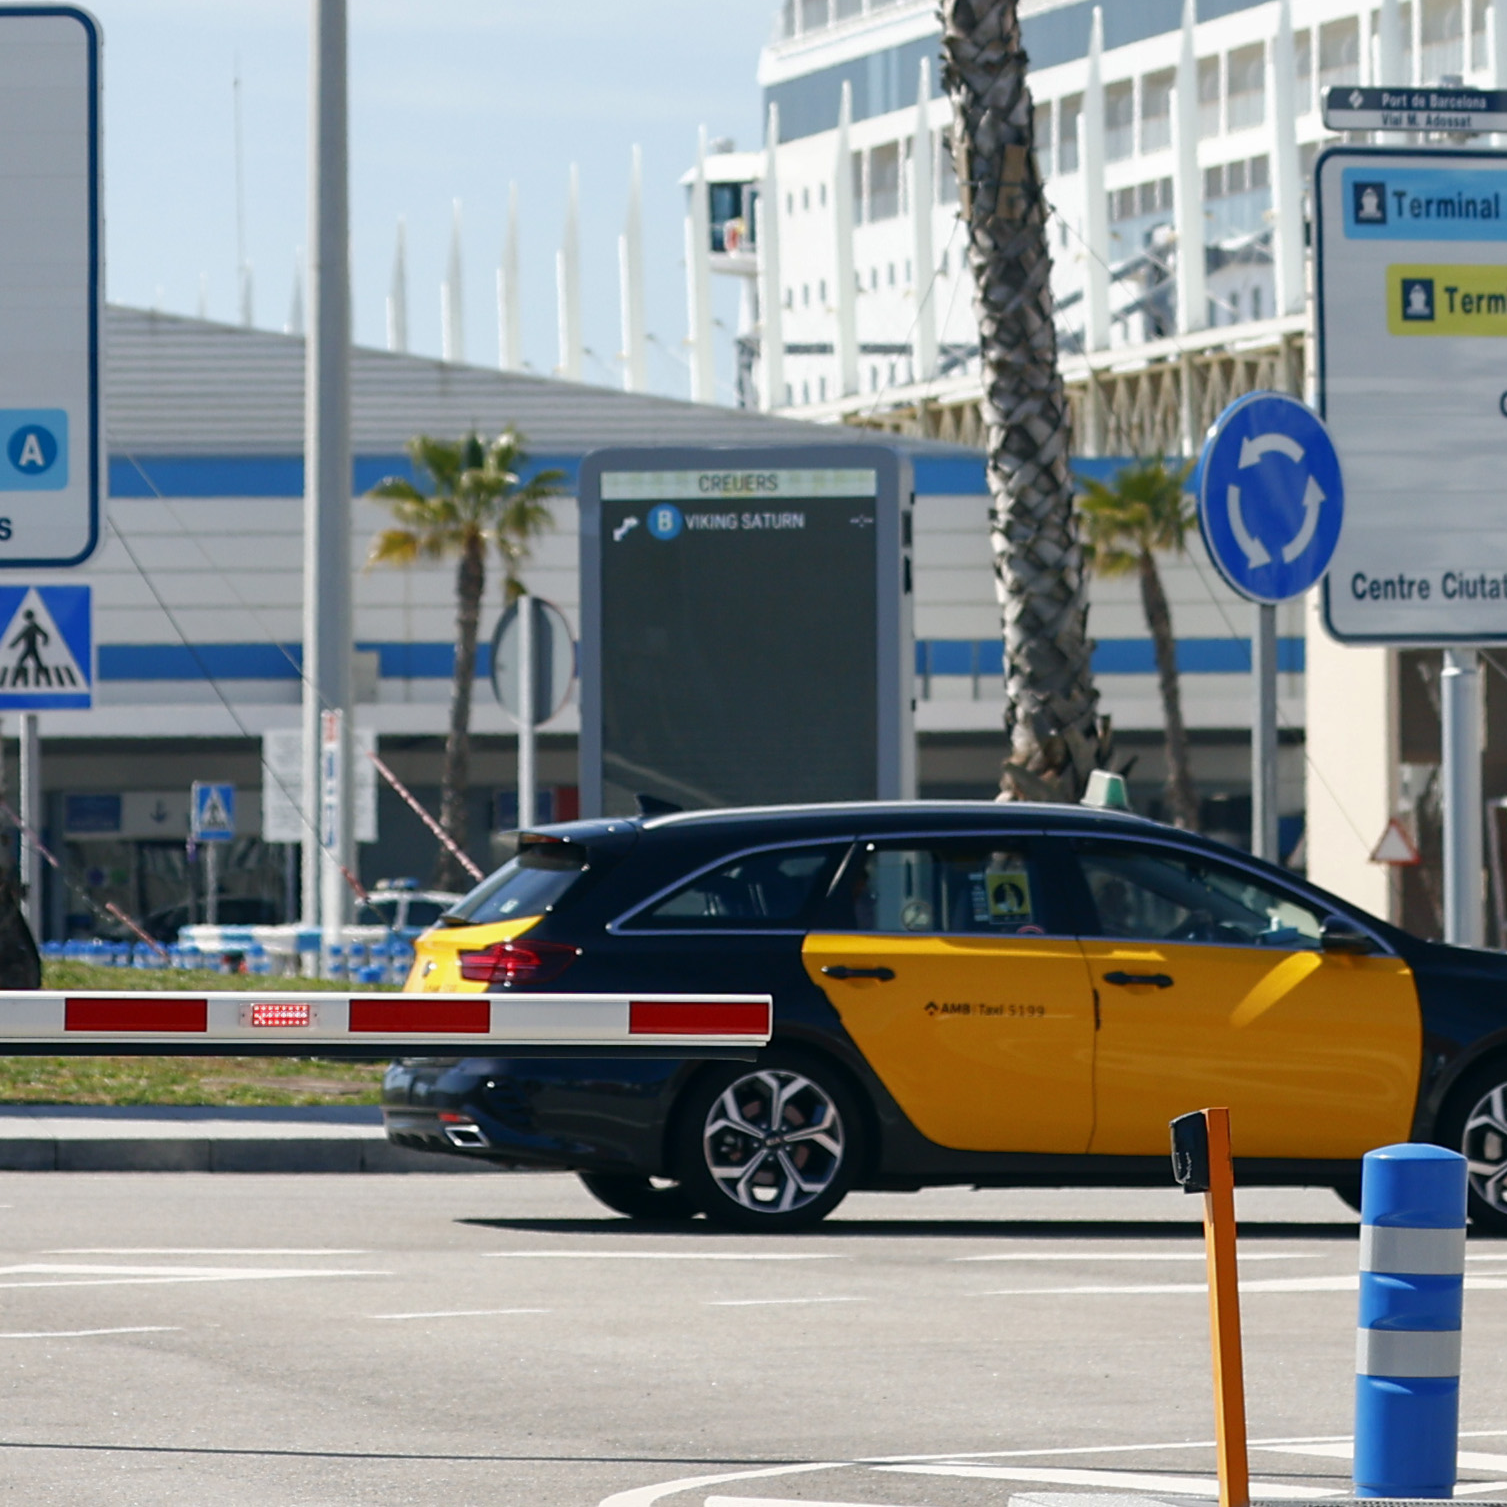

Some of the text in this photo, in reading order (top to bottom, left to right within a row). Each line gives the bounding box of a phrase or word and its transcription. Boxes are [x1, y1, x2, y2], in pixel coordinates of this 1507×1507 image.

[1382, 93, 1487, 109] Port de Barcelona
[1425, 115, 1472, 127] Adossat
[1393, 190, 1500, 219] Terminal
[18, 433, 45, 467] A
[699, 474, 779, 492] CREUERS
[657, 511, 805, 531] B VIKING SATURN
[1350, 571, 1431, 600] Centre
[941, 1003, 1045, 1017] AMB Taxi 5199
